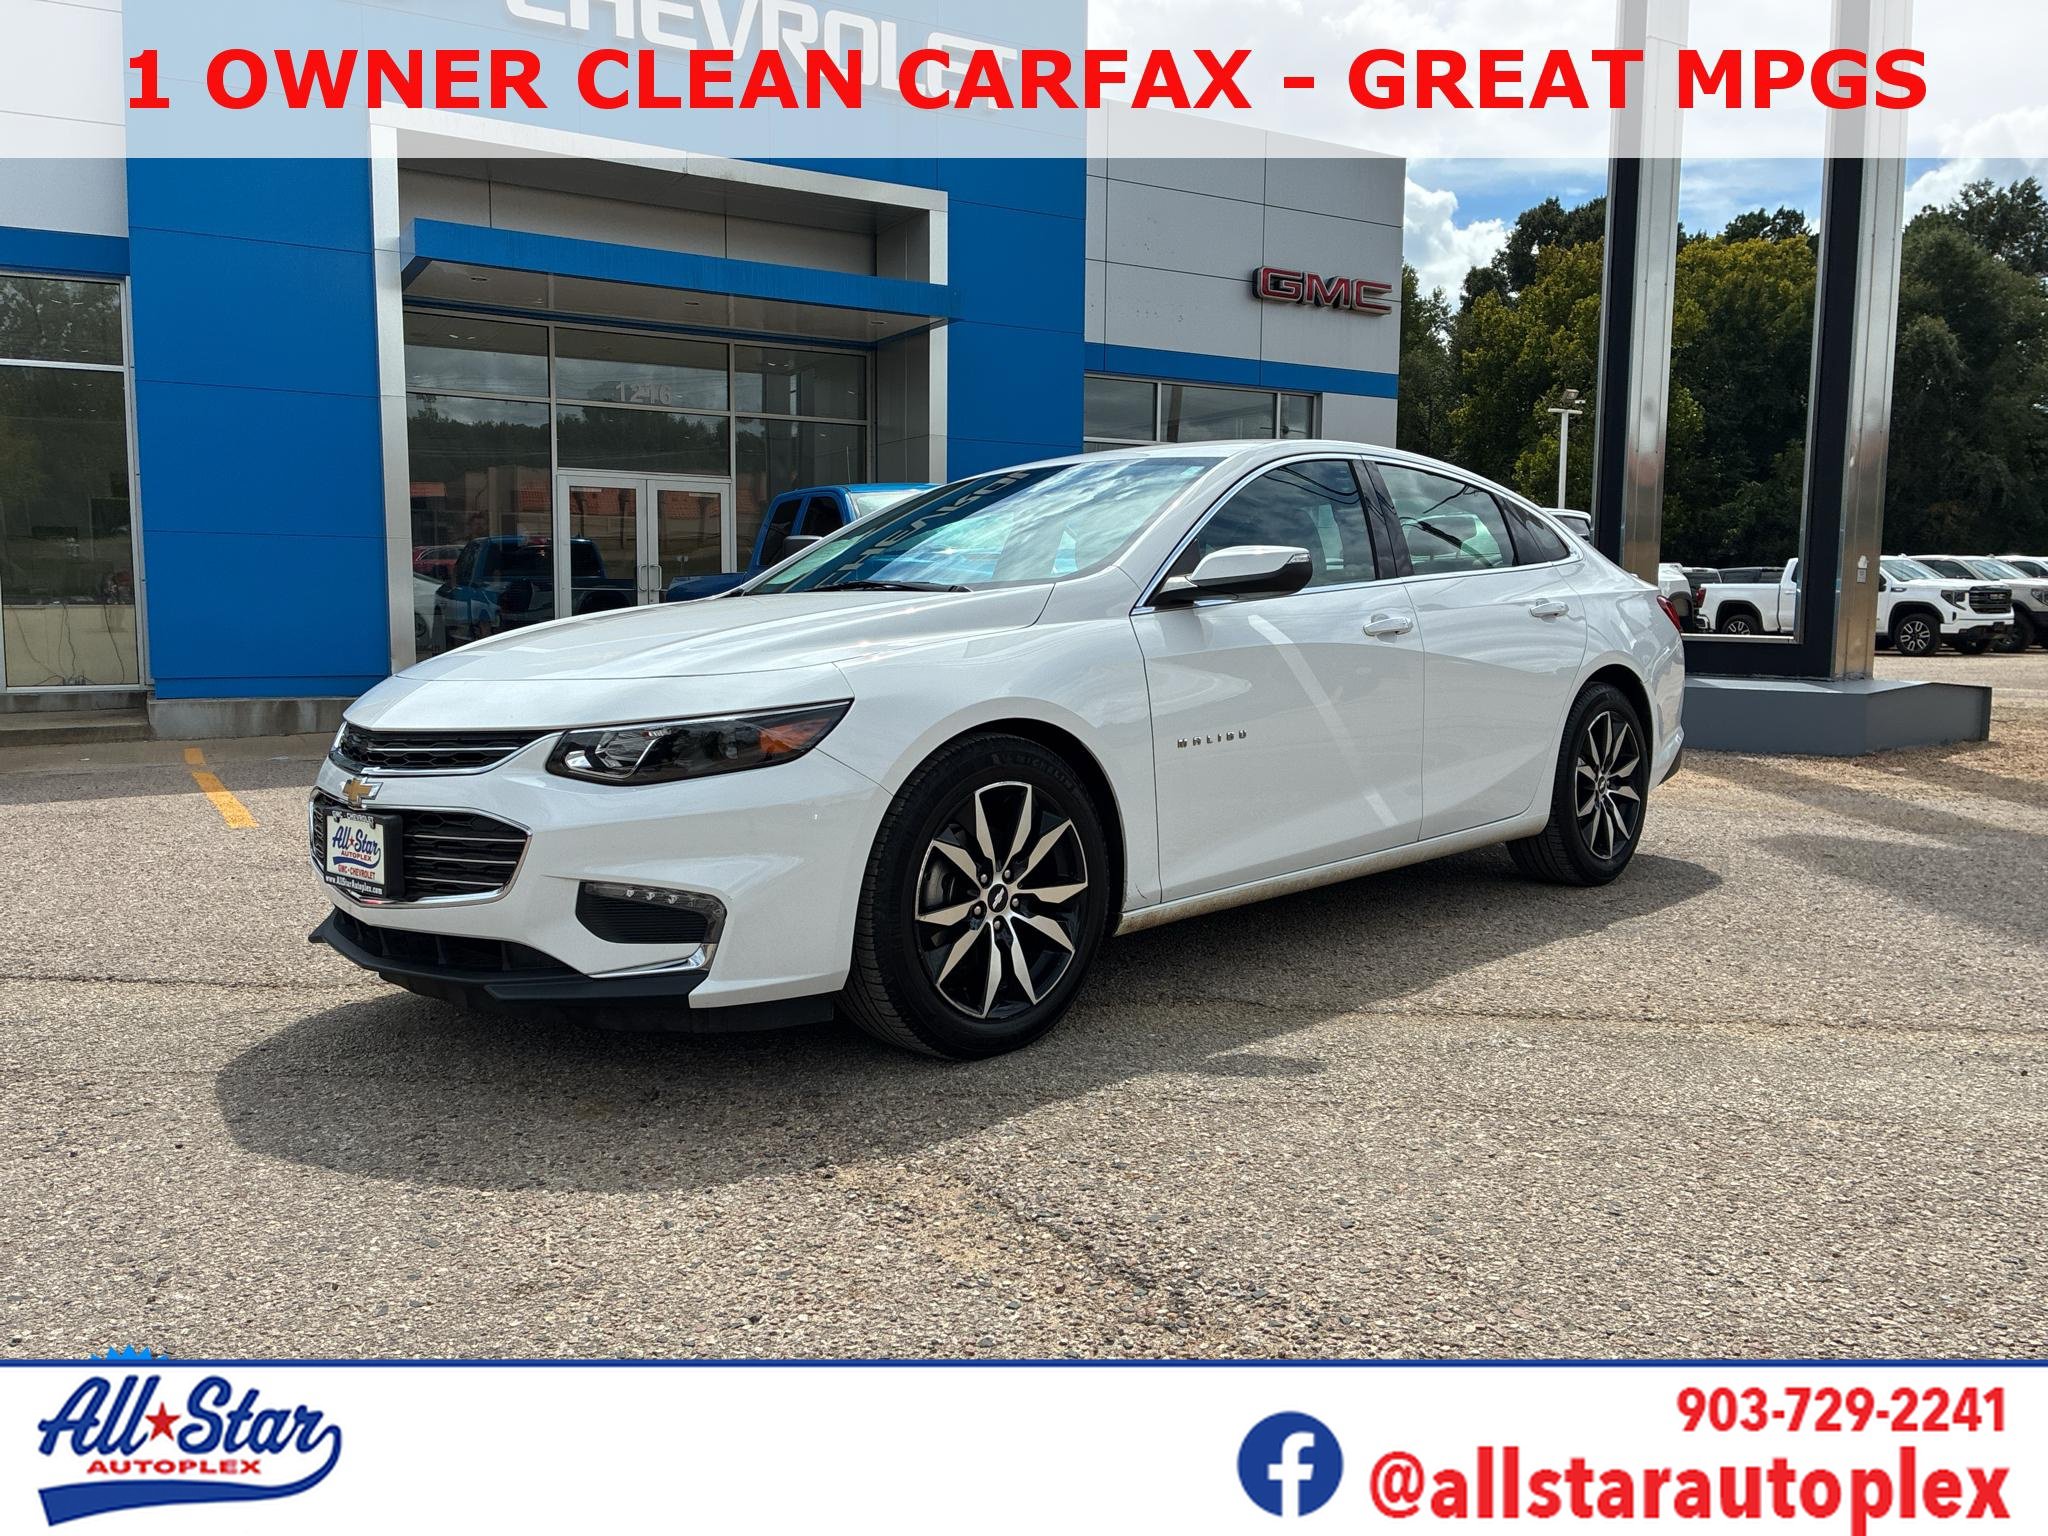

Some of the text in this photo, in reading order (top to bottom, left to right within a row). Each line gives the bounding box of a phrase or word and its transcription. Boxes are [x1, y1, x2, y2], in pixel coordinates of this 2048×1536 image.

[1252, 266, 1393, 315] GMC
[615, 382, 673, 405] 1216
[1177, 730, 1247, 748] MALIBU
[332, 826, 379, 855] All Star
[341, 850, 372, 861] AUTOPLEX
